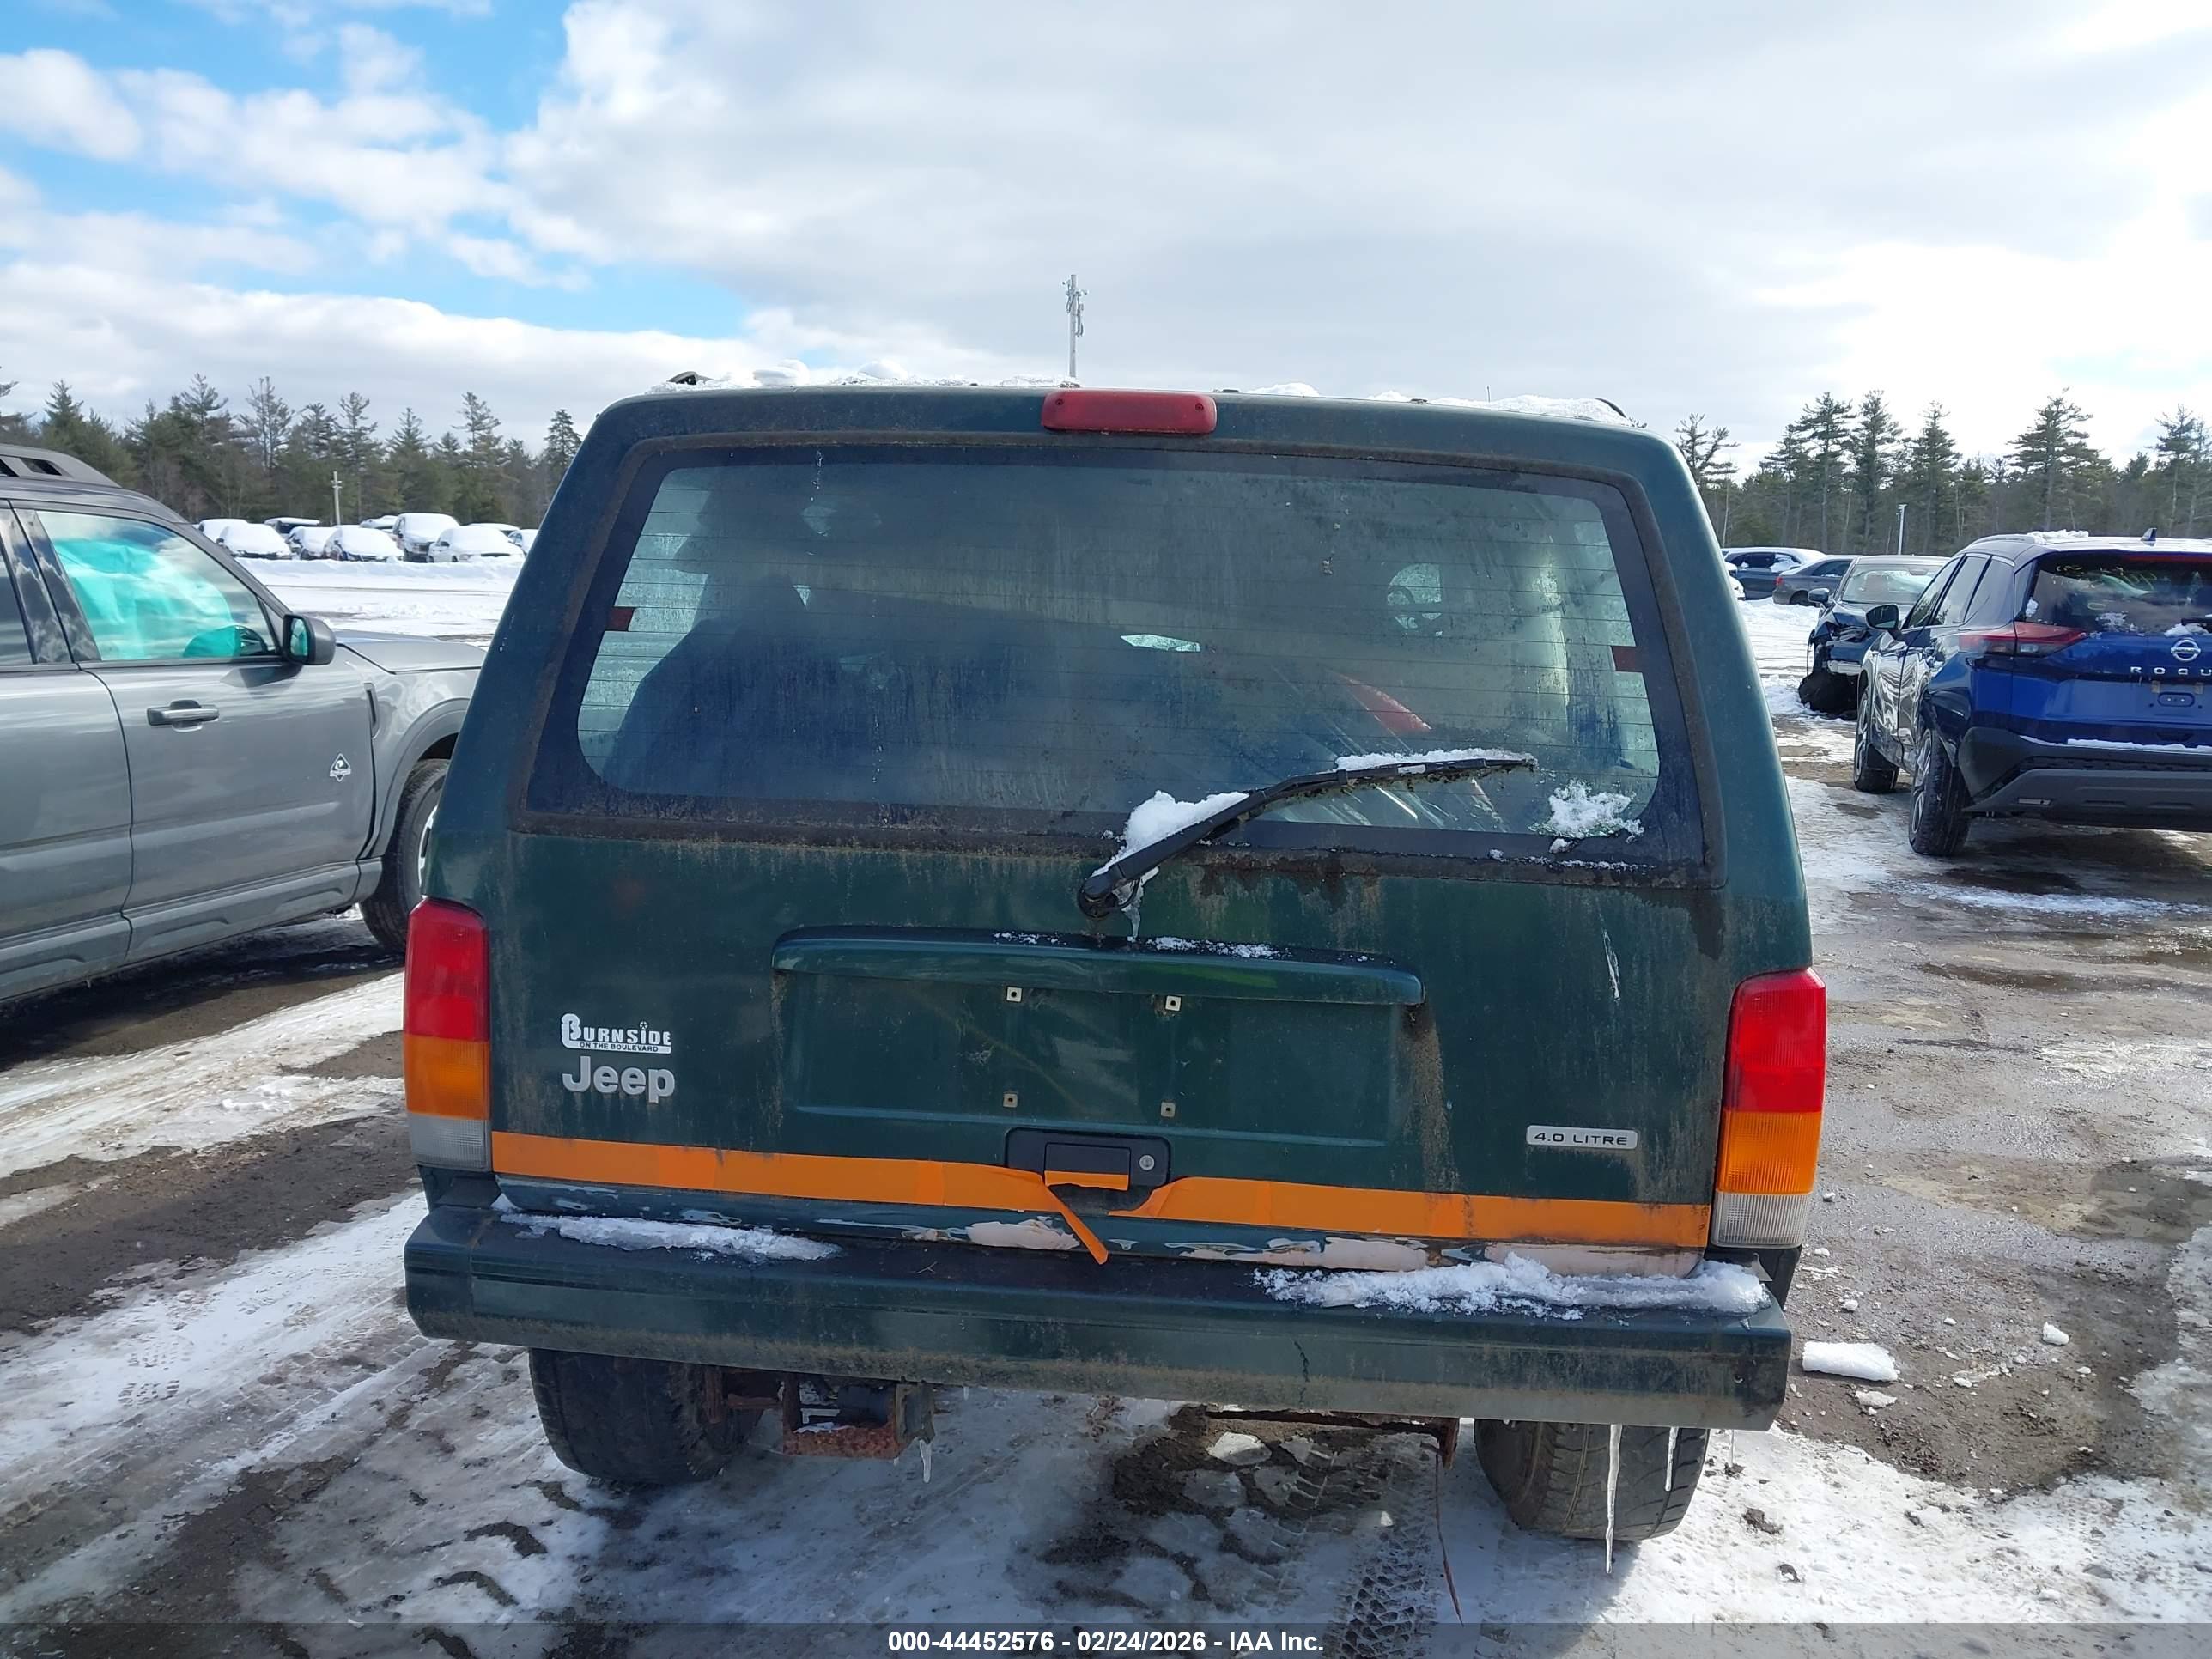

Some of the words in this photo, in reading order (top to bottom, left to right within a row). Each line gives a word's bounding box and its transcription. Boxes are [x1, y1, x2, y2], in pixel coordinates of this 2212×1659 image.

[611, 1043, 659, 1053] BOULEVARD
[562, 1055, 675, 1104] Jeep
[1534, 1133, 1565, 1143] 4.0
[1573, 1134, 1628, 1146] LITRE
